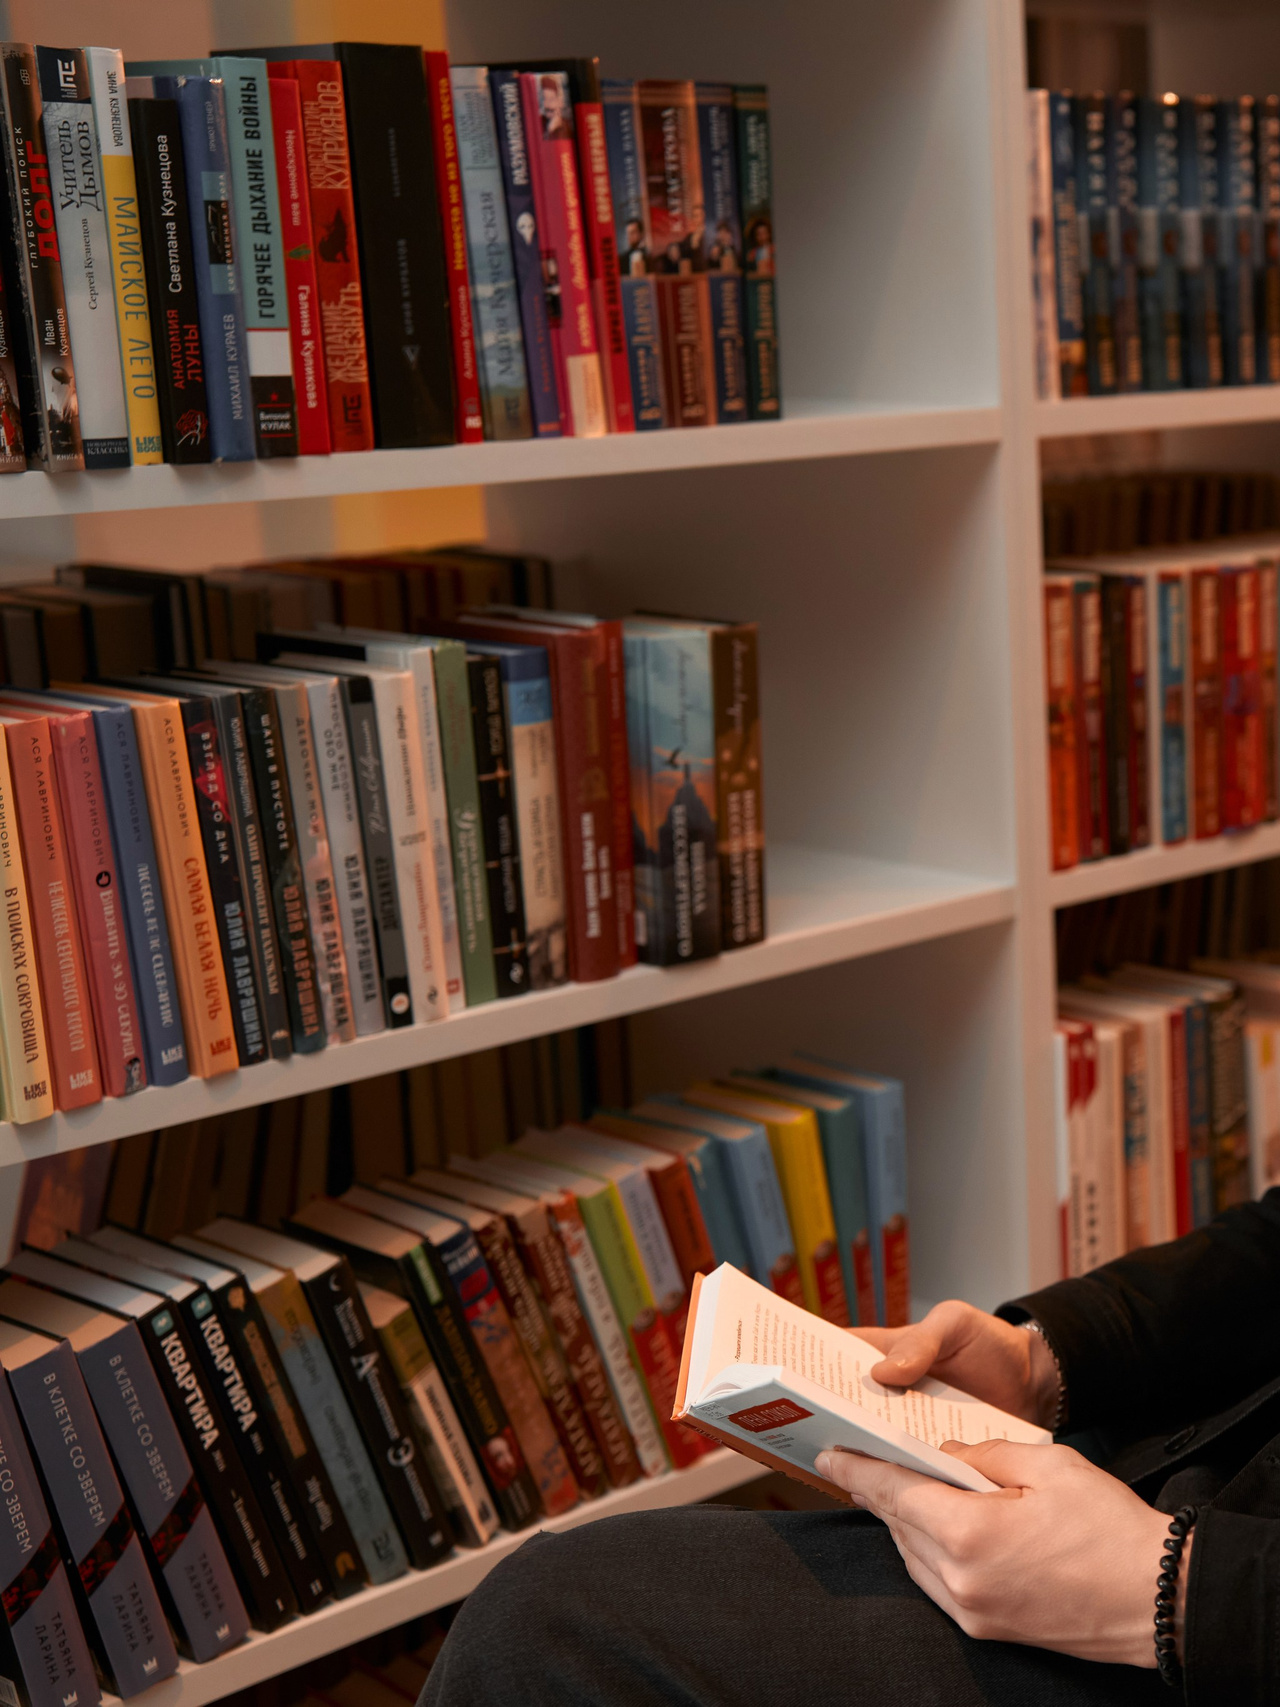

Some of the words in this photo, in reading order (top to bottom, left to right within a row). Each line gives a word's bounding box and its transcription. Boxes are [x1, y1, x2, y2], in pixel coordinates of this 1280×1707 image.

[106, 70, 118, 95] ЗИНА
[238, 76, 261, 140] ВОЙНЫ
[109, 97, 123, 147] КУЗНЕЦОВА
[303, 101, 328, 190] КОНСТАНТИН
[317, 80, 350, 190] КУПРИЯНОВ
[500, 82, 529, 186] РАЗУМОВСКИЙ
[14, 126, 27, 178] ПОИСК
[57, 120, 80, 211] Учитель
[77, 121, 102, 212] Дымов
[156, 134, 177, 217] Кузнецова
[285, 129, 300, 200] Неискренне
[25, 140, 60, 262] ДОЛГ
[246, 149, 271, 235] ДЫХАНИЕ
[290, 202, 301, 226] ваш
[22, 187, 38, 269] ГЛУБОКИЙ
[81, 218, 94, 268] Кузнецов
[165, 221, 183, 293] Светлана
[113, 197, 148, 321] МАЙСКОЕ
[253, 243, 275, 319] ГОРЯЧЕЕ
[85, 269, 98, 310] Сергей
[297, 285, 312, 336] Галина
[44, 319, 56, 346] Иван
[57, 308, 69, 357] Кузнецов
[166, 309, 186, 390] АНАТОМИЯ
[183, 324, 203, 382] ЛУНЫ
[223, 314, 238, 361] КУРАЕВ
[322, 300, 349, 384] ЖЕЛАНИЕ
[339, 281, 368, 384] ИСЧЕЗНУТЬ
[128, 337, 155, 399] ЛЕТО
[226, 366, 243, 420] МИХАИЛ
[301, 340, 318, 409] Куликова
[87, 447, 128, 455] КЛАССИКА
[260, 421, 291, 431] КУЛАК
[30, 736, 42, 764] АСЯ
[78, 736, 90, 764] АСЯ
[163, 717, 175, 744] АСЯ
[169, 749, 189, 838] ЛАВРИНОВИЧ
[201, 732, 218, 794] ВЗГЛЯД
[296, 717, 313, 792] ДЕВОЧКИ
[115, 721, 126, 749] АСЯ
[121, 753, 143, 843] ЛАВРИНОВИЧ
[260, 713, 275, 759] ШАГИ
[270, 780, 289, 851] ПУСТОТЕ
[35, 771, 56, 861] ЛАВРИНОВИЧ
[83, 771, 105, 866] ЛАВРИНОВИЧ
[211, 801, 223, 823] СО
[215, 829, 230, 864] ДНА
[4, 886, 18, 898] В
[48, 880, 70, 938] НЕЛЮБОВЬ
[184, 857, 207, 916] САМАЯ
[283, 884, 305, 933] ЮЛИЯ
[315, 877, 335, 925] ЮЛИЯ
[7, 901, 27, 970] ПОИСКАХ
[194, 922, 216, 972] БЕЛАЯ
[224, 900, 247, 950] ЮЛИЯ
[351, 906, 377, 1003] ЛАВРЯШИНА
[56, 938, 80, 1010] СЕРОГЛАЗОГО
[152, 953, 174, 1029] СЦЕНАРИЮ
[203, 975, 222, 1021] НОЧЬ
[291, 939, 320, 1037] ЛАВРЯШИНА
[323, 931, 349, 1028] ЛАВРЯШИНА
[16, 973, 39, 1064] СОКРОВИЩА
[66, 1009, 86, 1052] КОРОЛЯ
[233, 954, 263, 1056] ЛАВРЯШИНА
[25, 1087, 47, 1101] BOOK
[70, 1076, 93, 1090] BOOK
[43, 1372, 56, 1385] В
[109, 1354, 122, 1367] В
[200, 1314, 258, 1434] КВАРТИРА
[48, 1386, 78, 1445] КЛЕТКЕ
[114, 1367, 145, 1425] КЛЕТКЕ
[160, 1331, 220, 1450] КВАРТИРА
[760, 1404, 802, 1421] СОКОЛ
[69, 1446, 86, 1469] СО
[137, 1424, 153, 1446] СО
[77, 1469, 107, 1528] ЗВЕРЕМ
[146, 1447, 175, 1501] ЗВЕРЕМ
[5, 1494, 33, 1554] ЗВЕРЕМ
[184, 1564, 211, 1620] ЛАРИНА
[198, 1553, 225, 1612] ТАТЬЯНА
[112, 1594, 139, 1652] ЛАРИНА
[126, 1581, 154, 1645] ТАТЬЯНА
[34, 1625, 61, 1685] ЛАРИНА
[50, 1611, 77, 1678] ТАТЬЯНА
